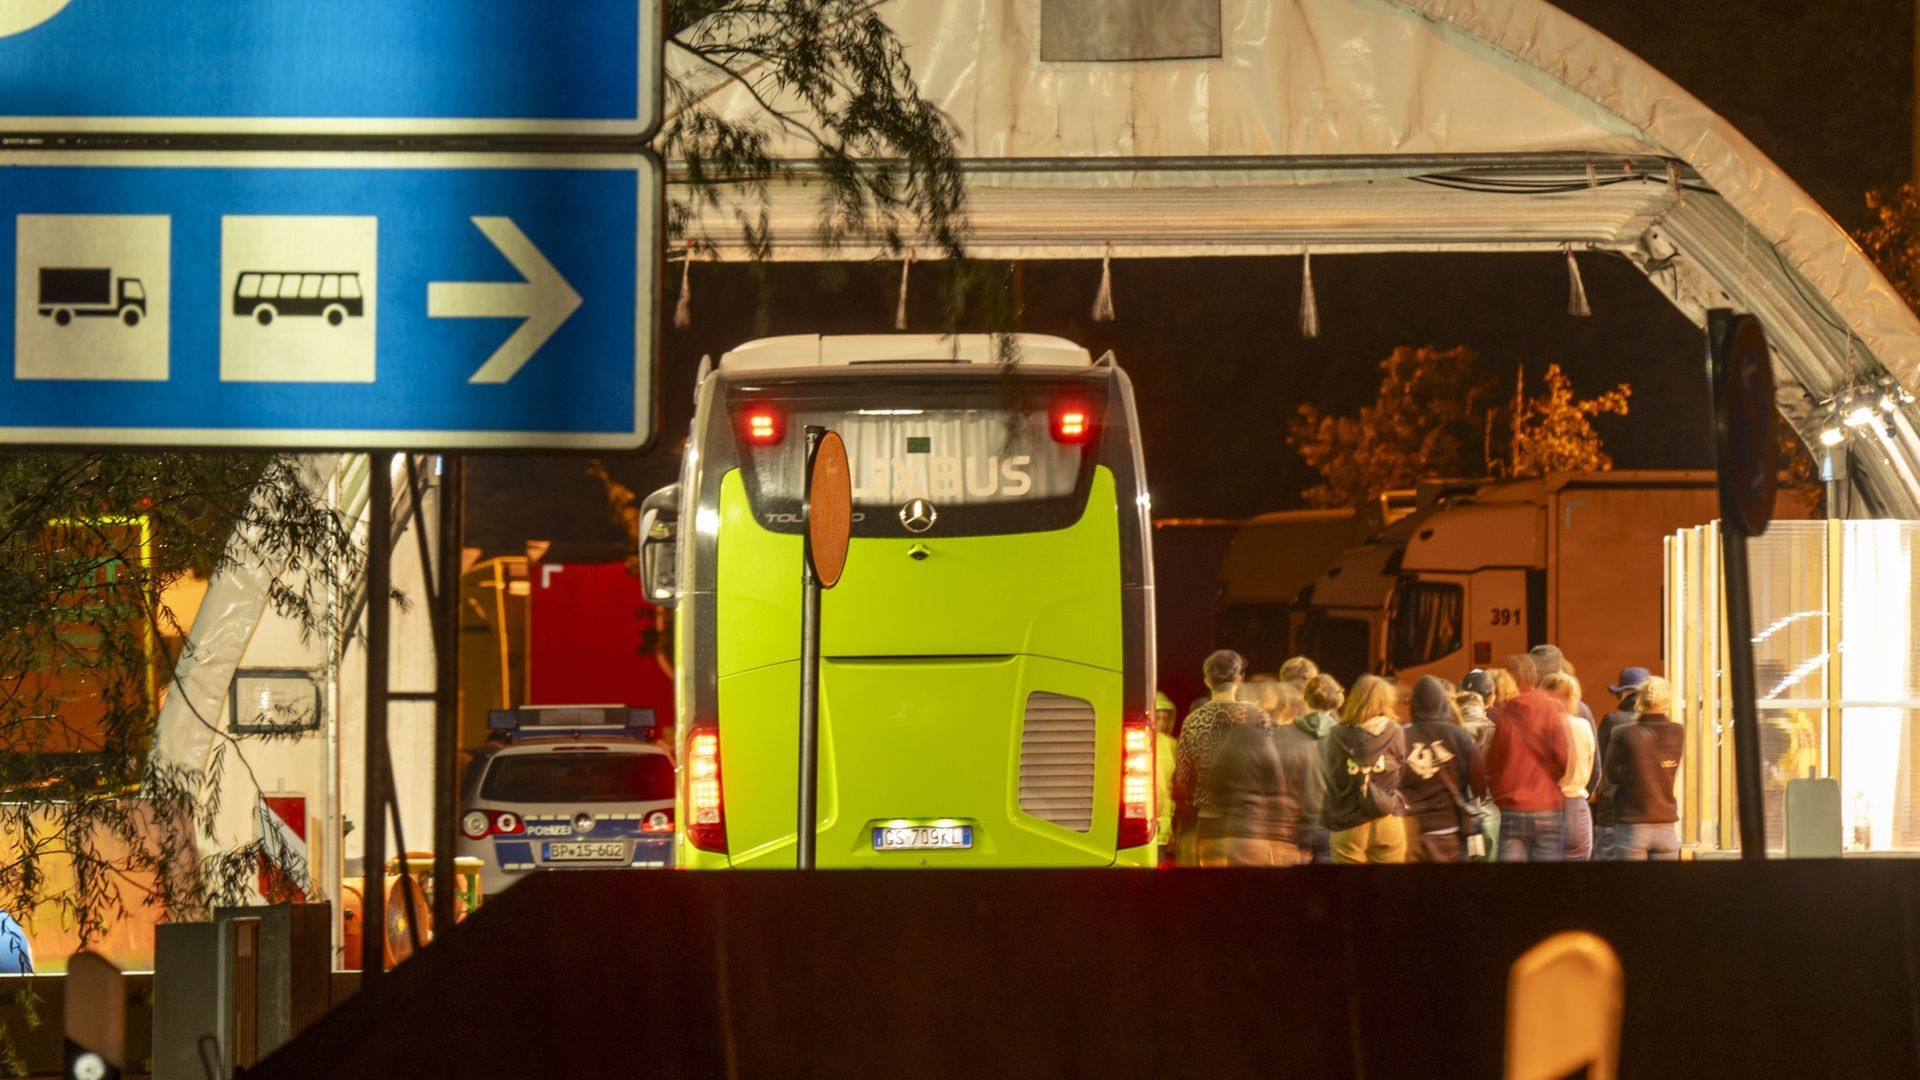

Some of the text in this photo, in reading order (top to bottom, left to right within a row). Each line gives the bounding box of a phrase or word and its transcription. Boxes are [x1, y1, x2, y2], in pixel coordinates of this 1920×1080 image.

[1490, 607, 1521, 627] 391
[527, 825, 573, 836] POLIZEI
[885, 829, 961, 846] GS 709KL
